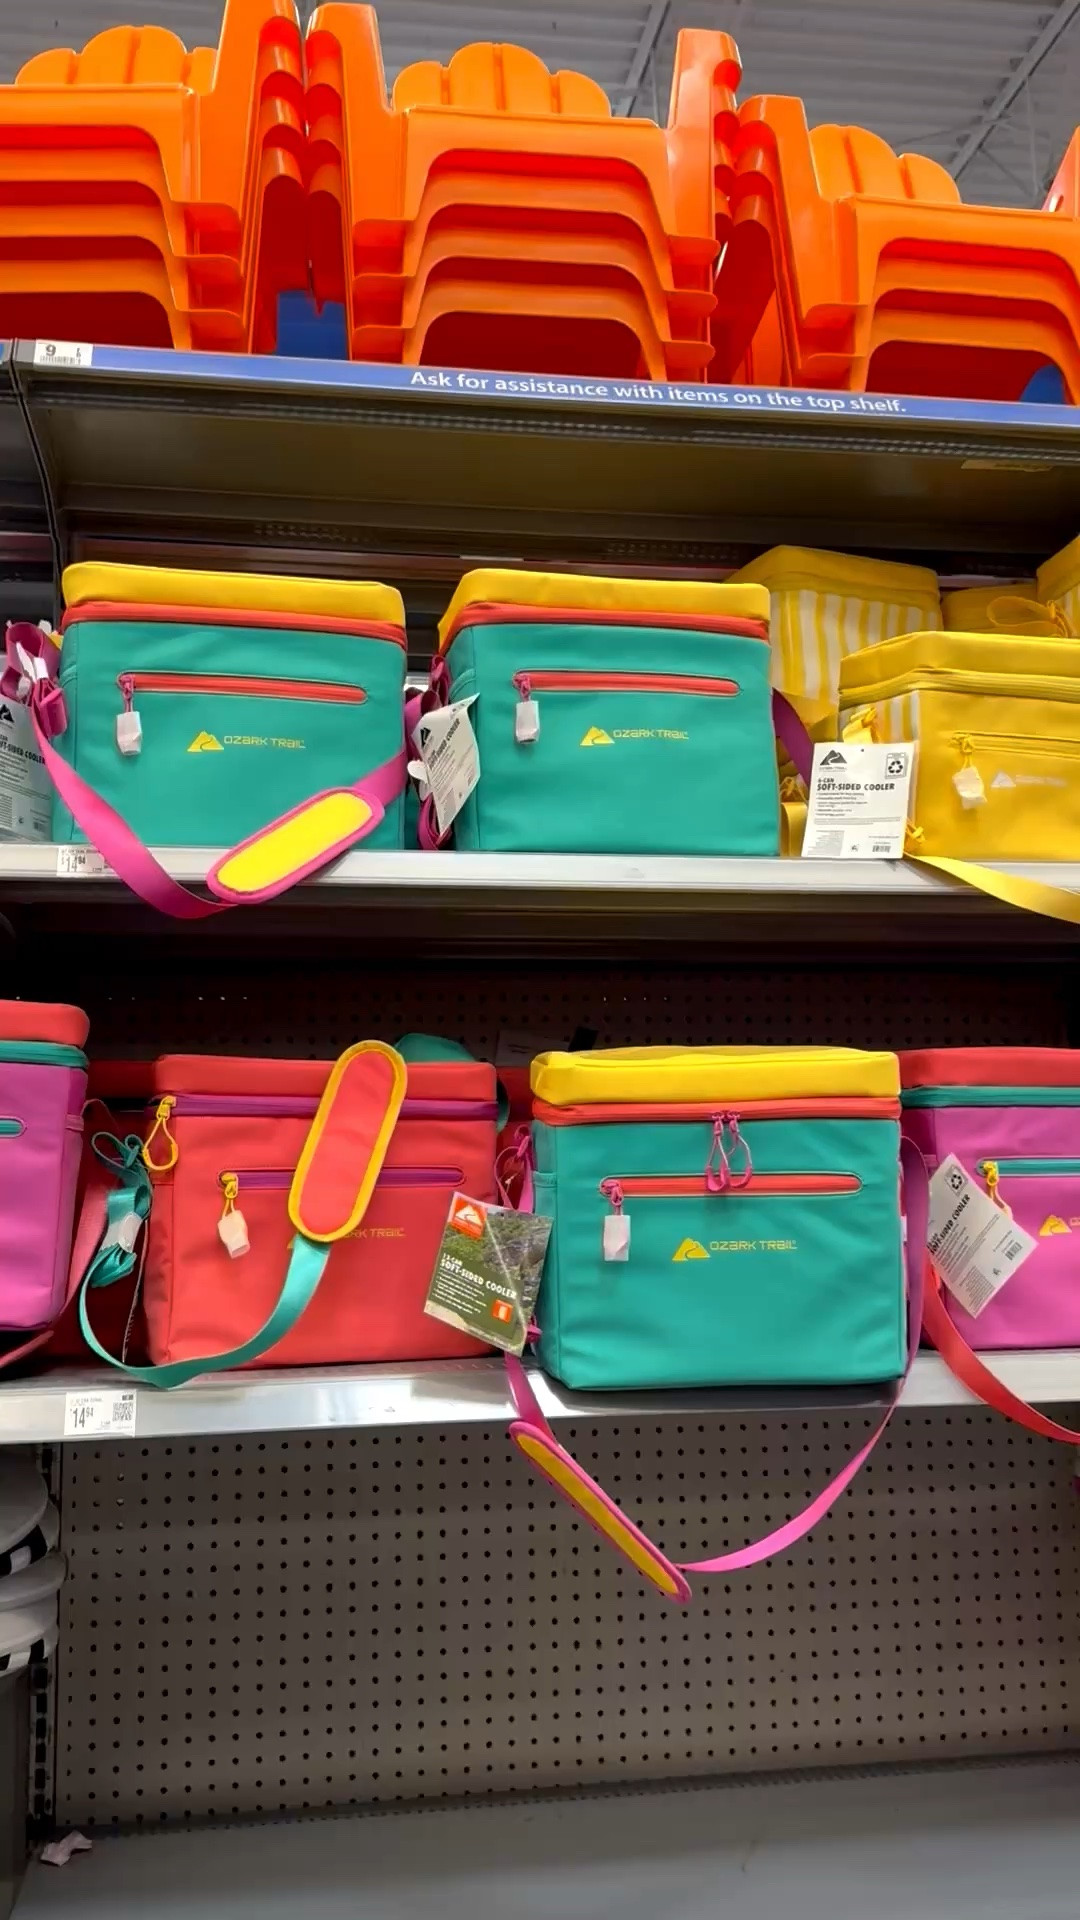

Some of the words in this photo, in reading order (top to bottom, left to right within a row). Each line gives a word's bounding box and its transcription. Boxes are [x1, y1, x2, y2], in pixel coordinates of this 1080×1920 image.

[45, 344, 57, 357] 9
[411, 371, 452, 387] Ask
[456, 374, 489, 390] for
[495, 378, 608, 396] assistance
[613, 384, 663, 400] with
[667, 386, 729, 403] items
[733, 392, 762, 405] on
[767, 392, 803, 406] the
[807, 395, 846, 412] top
[850, 397, 907, 412] shelf.
[612, 729, 655, 738] OZARK
[656, 729, 689, 740] TRAIL
[223, 735, 268, 746] OZARK
[270, 737, 306, 749] TRAIL
[817, 783, 862, 791] SOFT-SIDED
[864, 783, 895, 791] COOLER
[951, 1194, 970, 1220] COOLER
[709, 1240, 757, 1251] OZARK
[759, 1239, 798, 1251] TRAIL
[441, 1259, 484, 1287] SOFT-SIDED
[485, 1280, 517, 1299] COOLER
